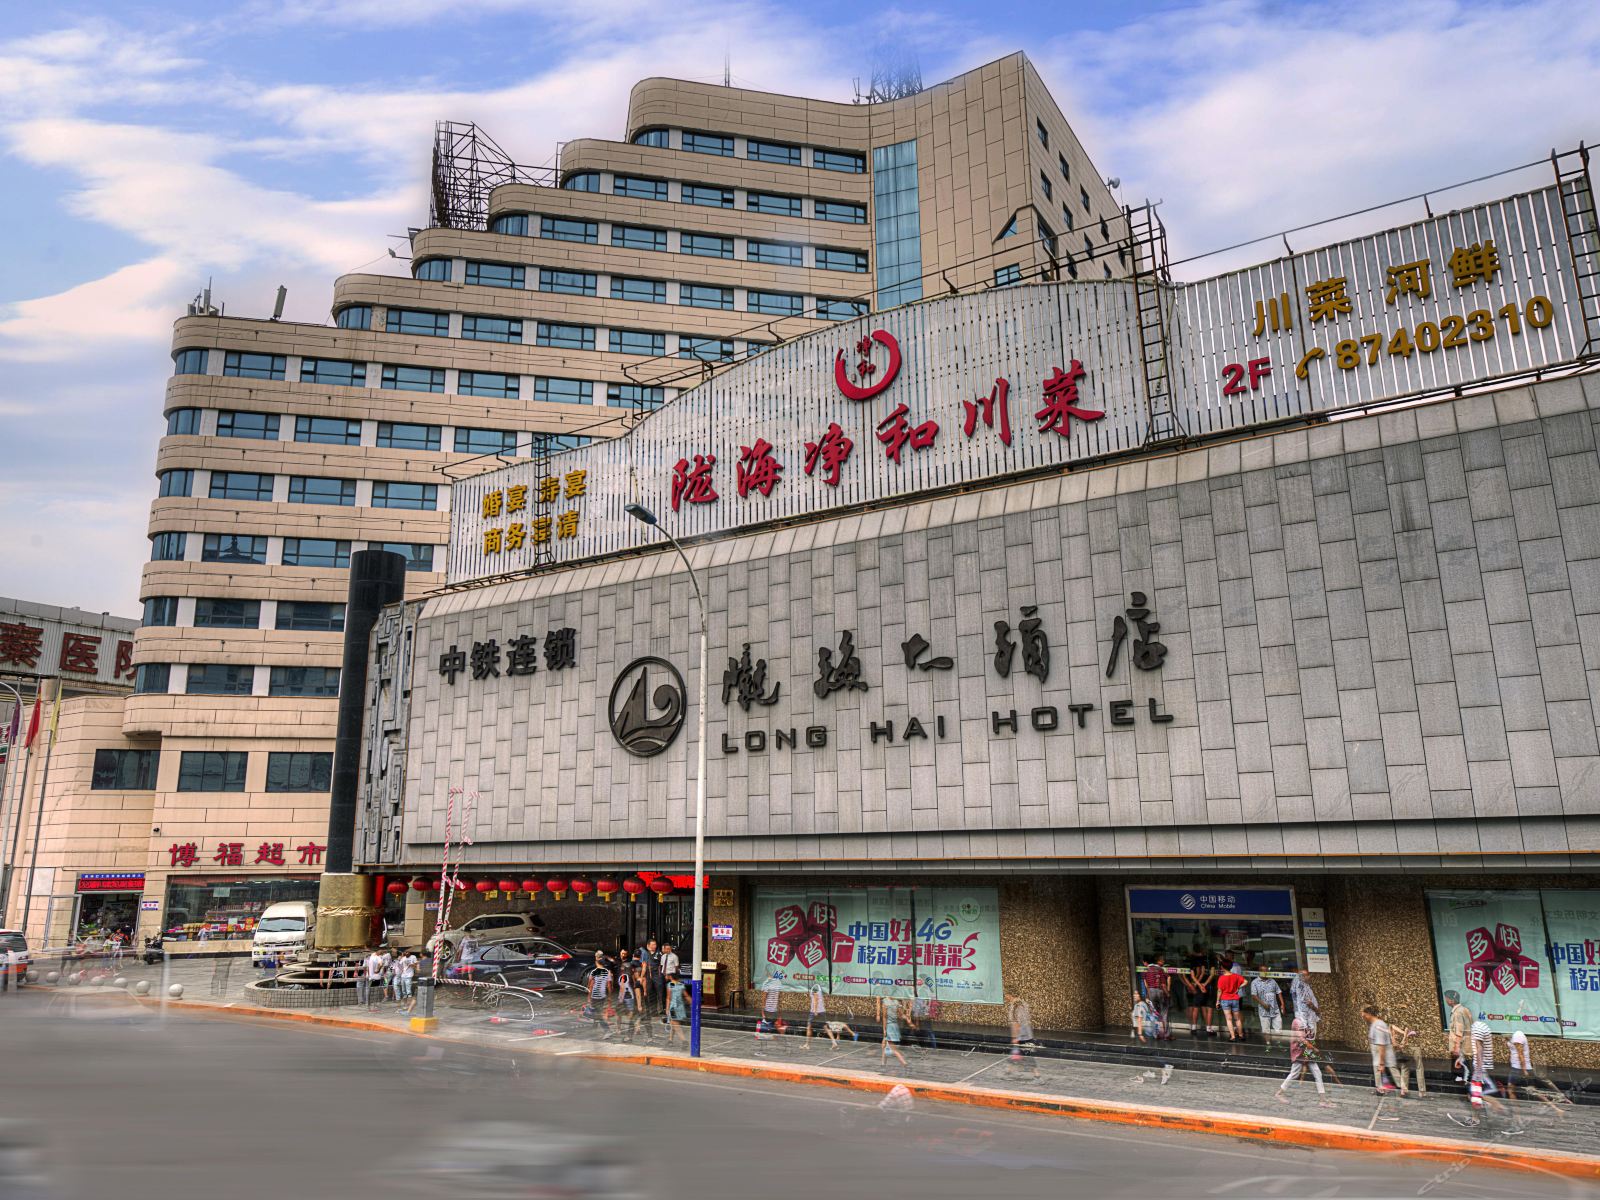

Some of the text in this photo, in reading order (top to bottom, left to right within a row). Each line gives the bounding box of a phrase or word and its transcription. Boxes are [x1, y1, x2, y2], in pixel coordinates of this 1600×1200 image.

[1221, 295, 1554, 396] 2F 87402310
[670, 358, 1106, 513] 陇海净和川菜
[438, 626, 577, 686] 中铁连锁
[721, 696, 1174, 754] LONG HAI HOTEL
[168, 841, 327, 868] 博福超市
[1200, 894, 1236, 904] 中国移动
